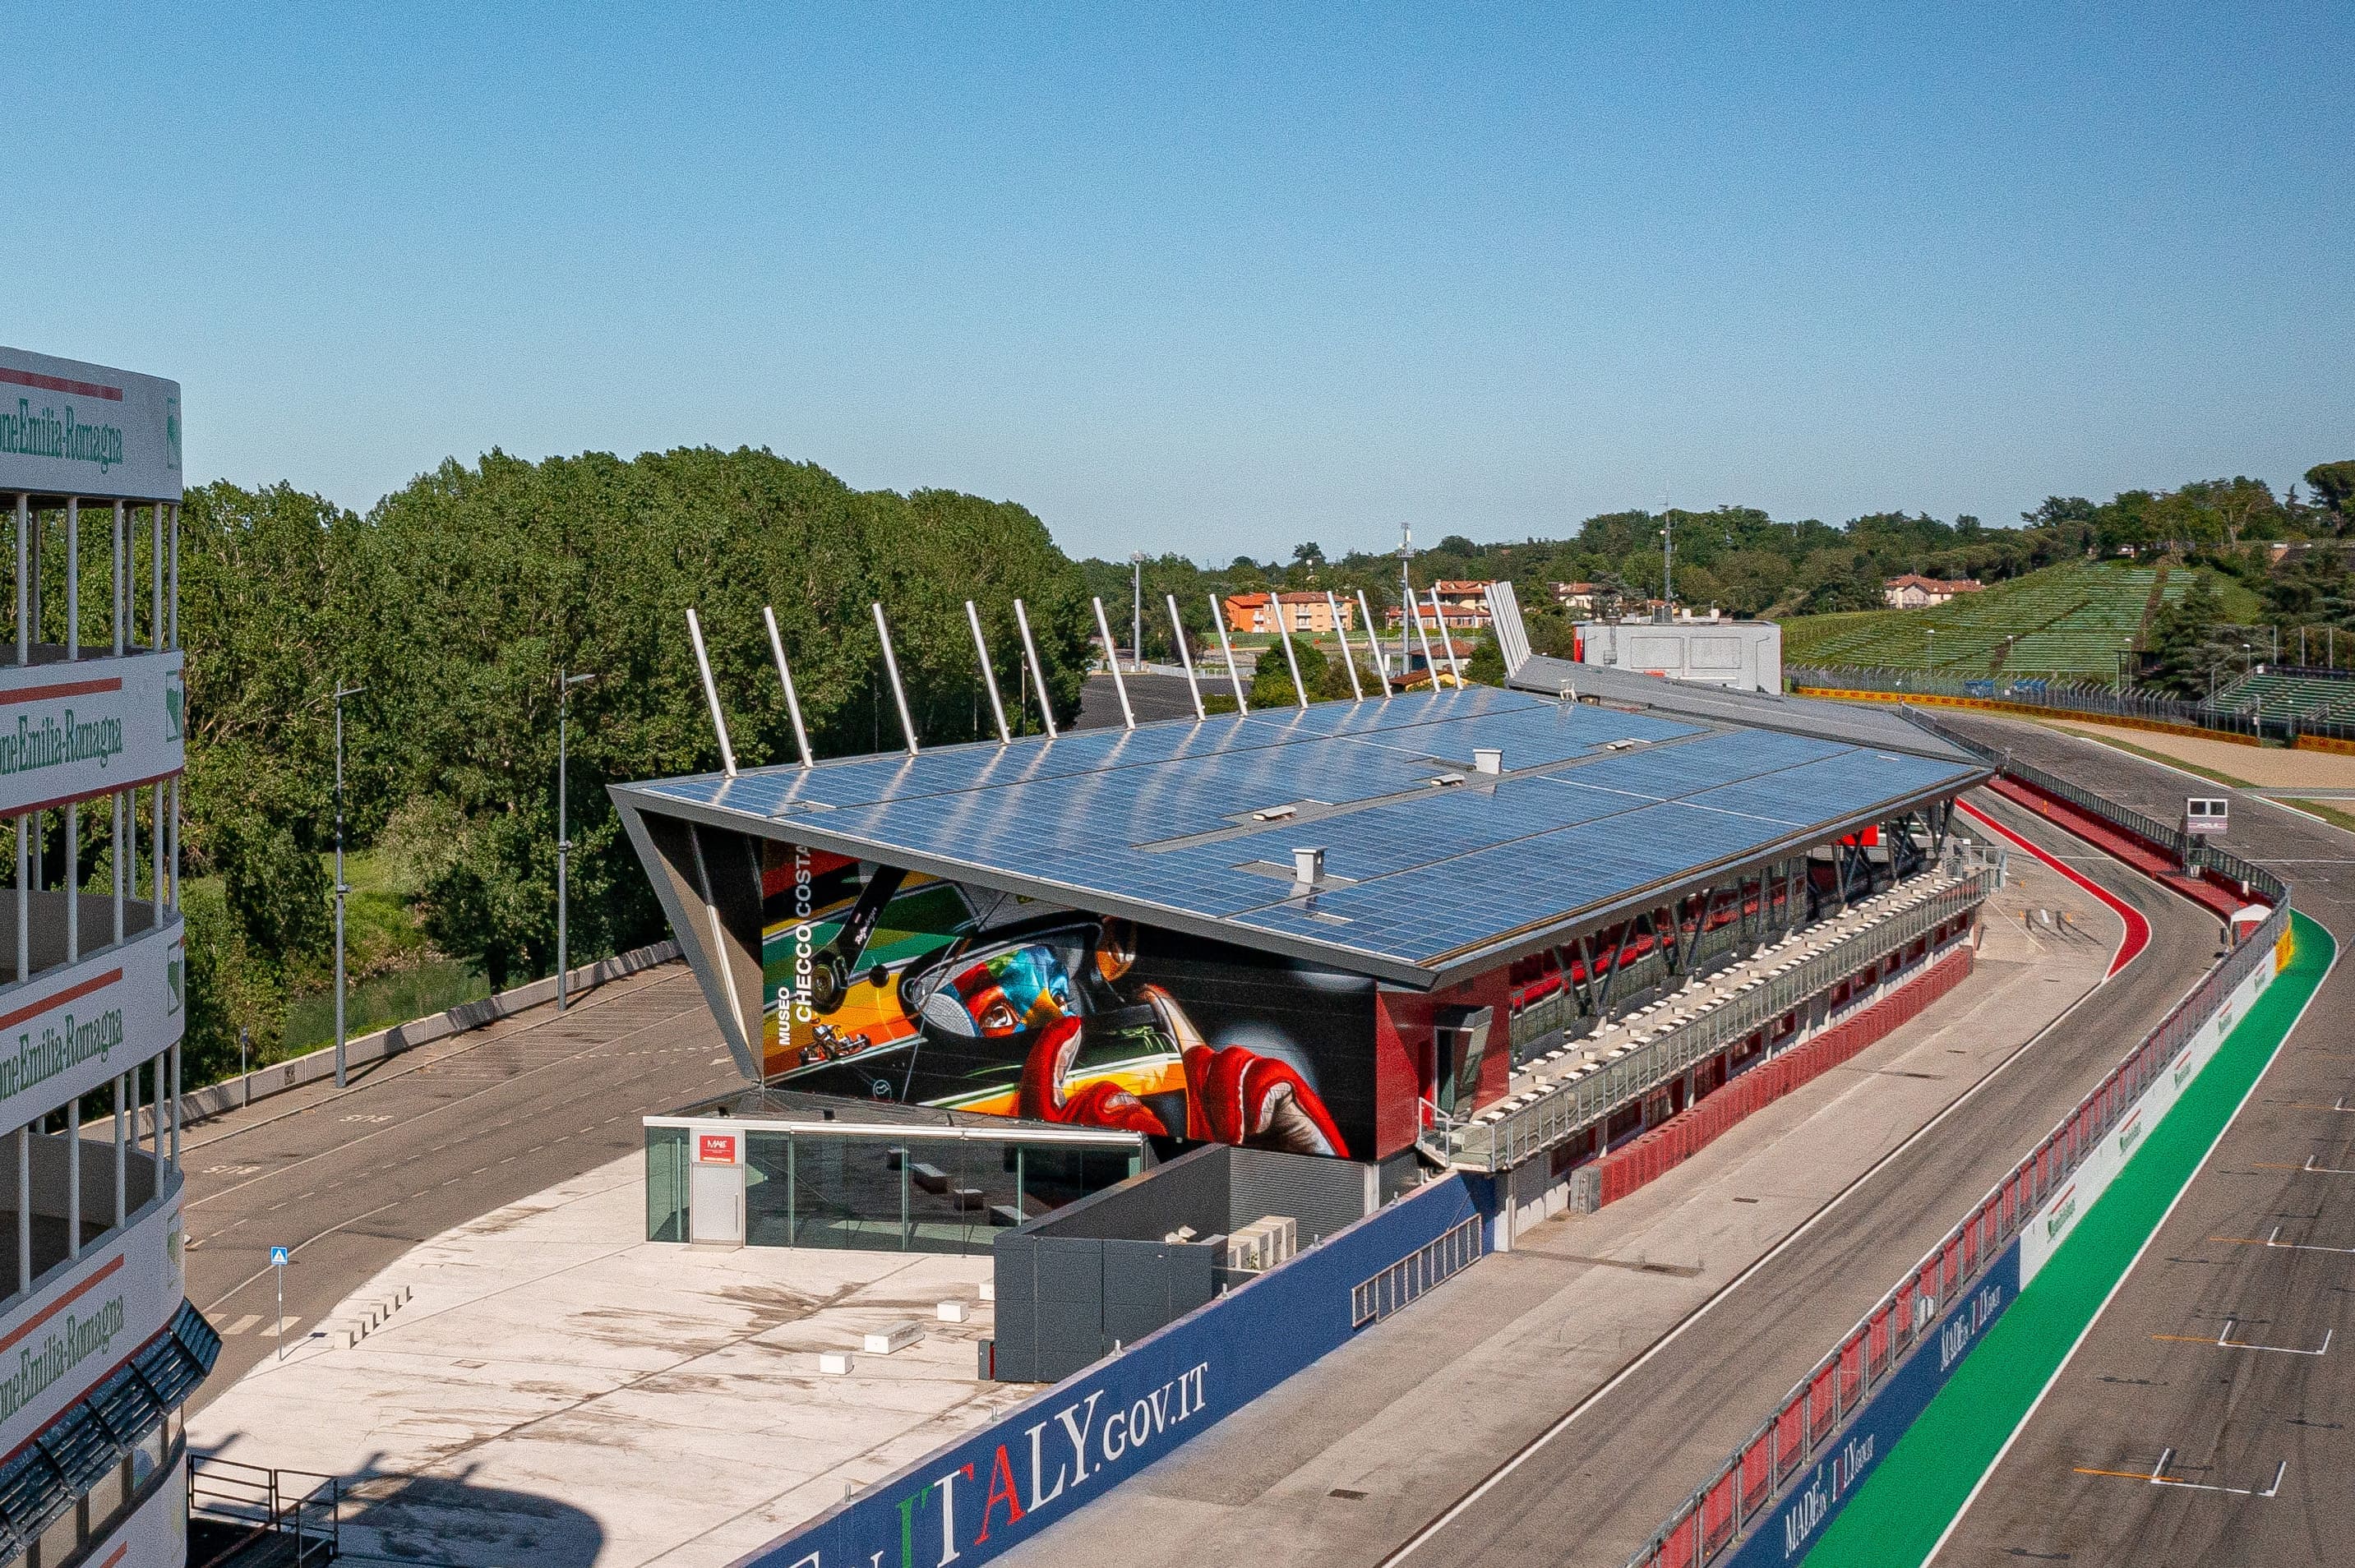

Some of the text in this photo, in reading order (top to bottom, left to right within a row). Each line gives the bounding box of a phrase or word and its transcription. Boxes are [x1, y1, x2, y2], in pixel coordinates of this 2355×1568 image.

[795, 846, 812, 1022] CHECCO COSTA
[778, 986, 790, 1045] MUSEO
